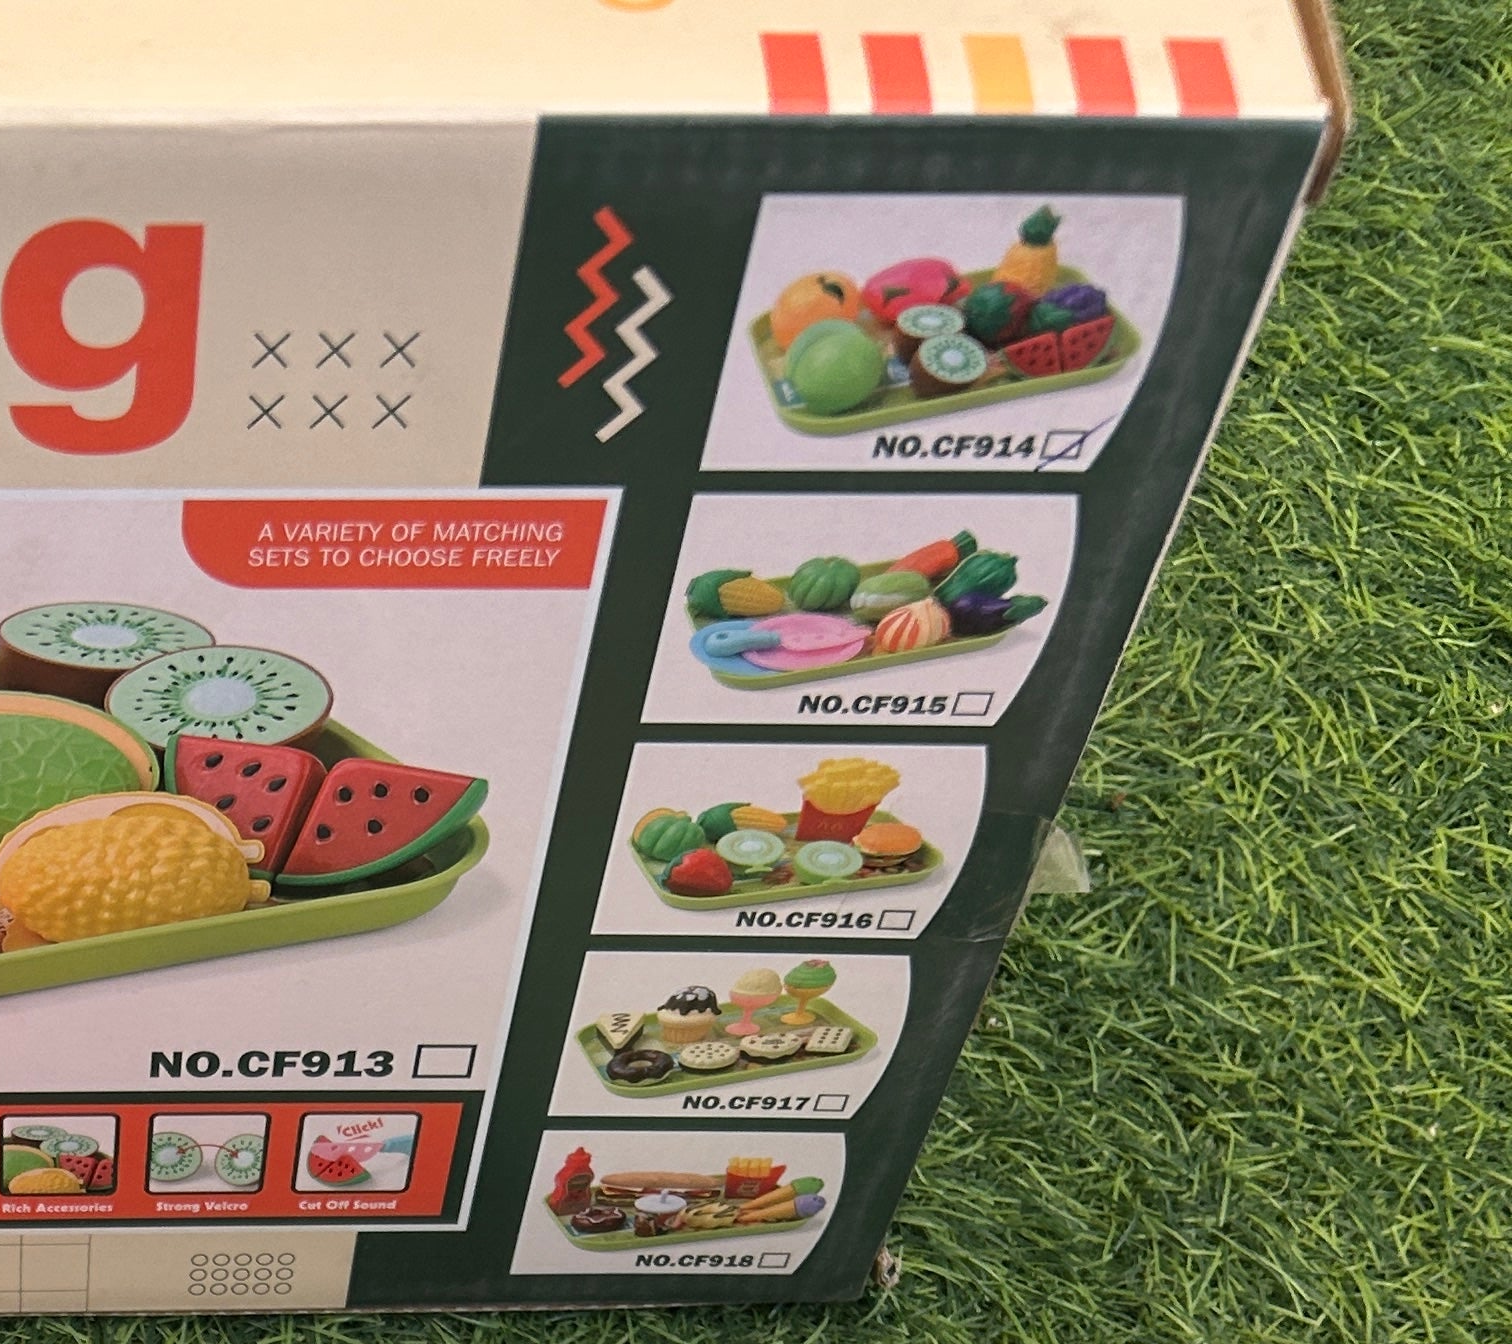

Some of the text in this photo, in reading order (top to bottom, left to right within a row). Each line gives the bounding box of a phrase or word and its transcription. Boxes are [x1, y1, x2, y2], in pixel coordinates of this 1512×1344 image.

[872, 434, 1036, 460] NO.CF914
[257, 521, 564, 543] A VARIETY OF MATCHING
[247, 548, 562, 568] SETS TO CHOOSE FREELY
[797, 694, 949, 717] NO.CF915
[735, 910, 874, 930] NO.CF916
[149, 1048, 396, 1080] NO.CF913
[682, 1095, 812, 1112] NO.CF917
[1, 1202, 114, 1214] Rich Accessories
[155, 1201, 249, 1213] Strong Velcro
[298, 1199, 398, 1211] Cut Off Sound
[634, 1253, 755, 1268] NO.CF918
